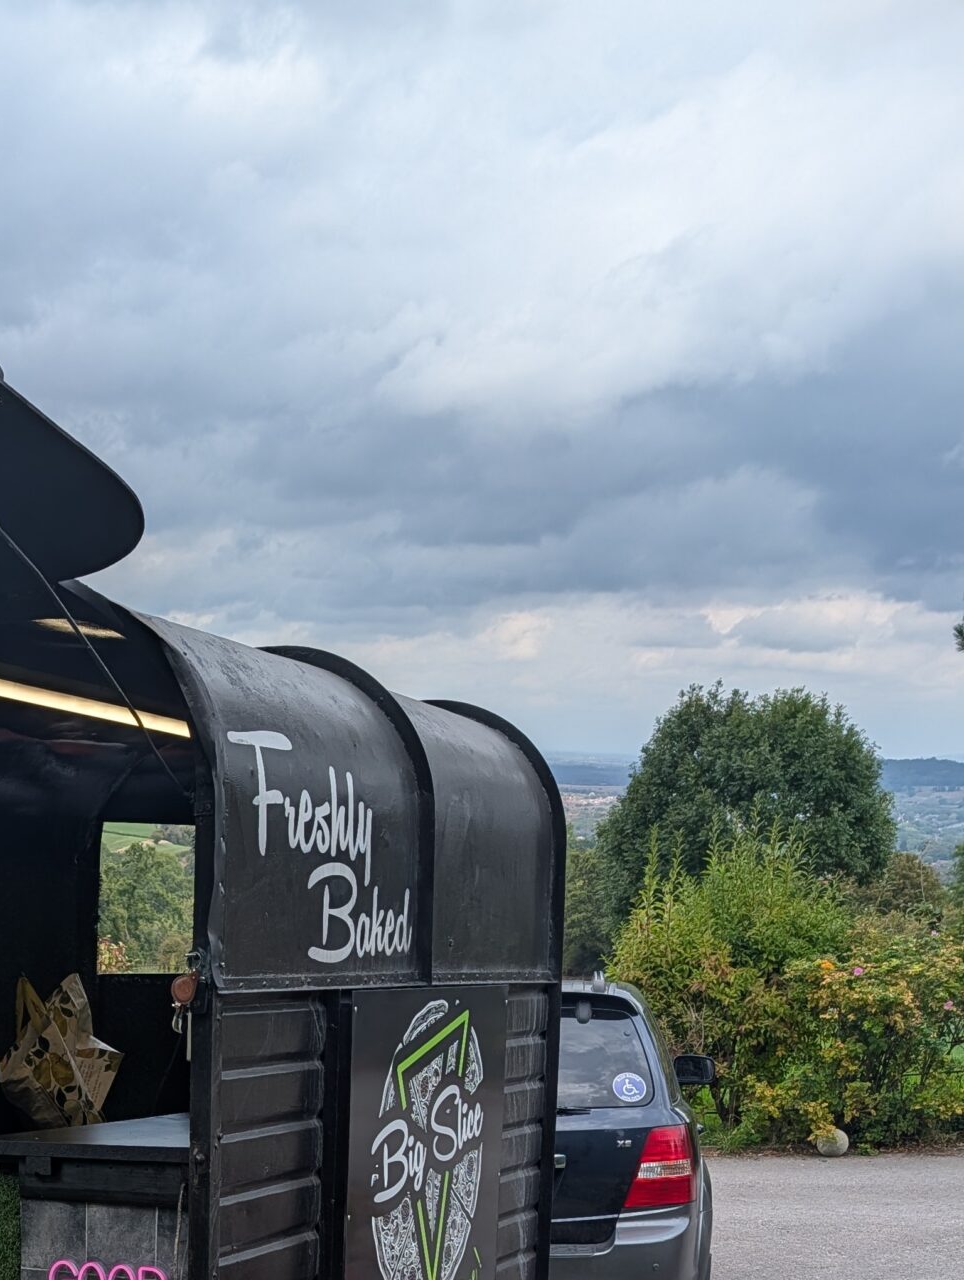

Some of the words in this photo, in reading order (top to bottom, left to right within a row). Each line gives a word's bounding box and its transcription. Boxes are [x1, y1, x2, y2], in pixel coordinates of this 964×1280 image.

[226, 730, 373, 888] Freshly
[307, 861, 413, 964] Baked
[371, 1118, 428, 1203] Big
[431, 1084, 484, 1162] Slice
